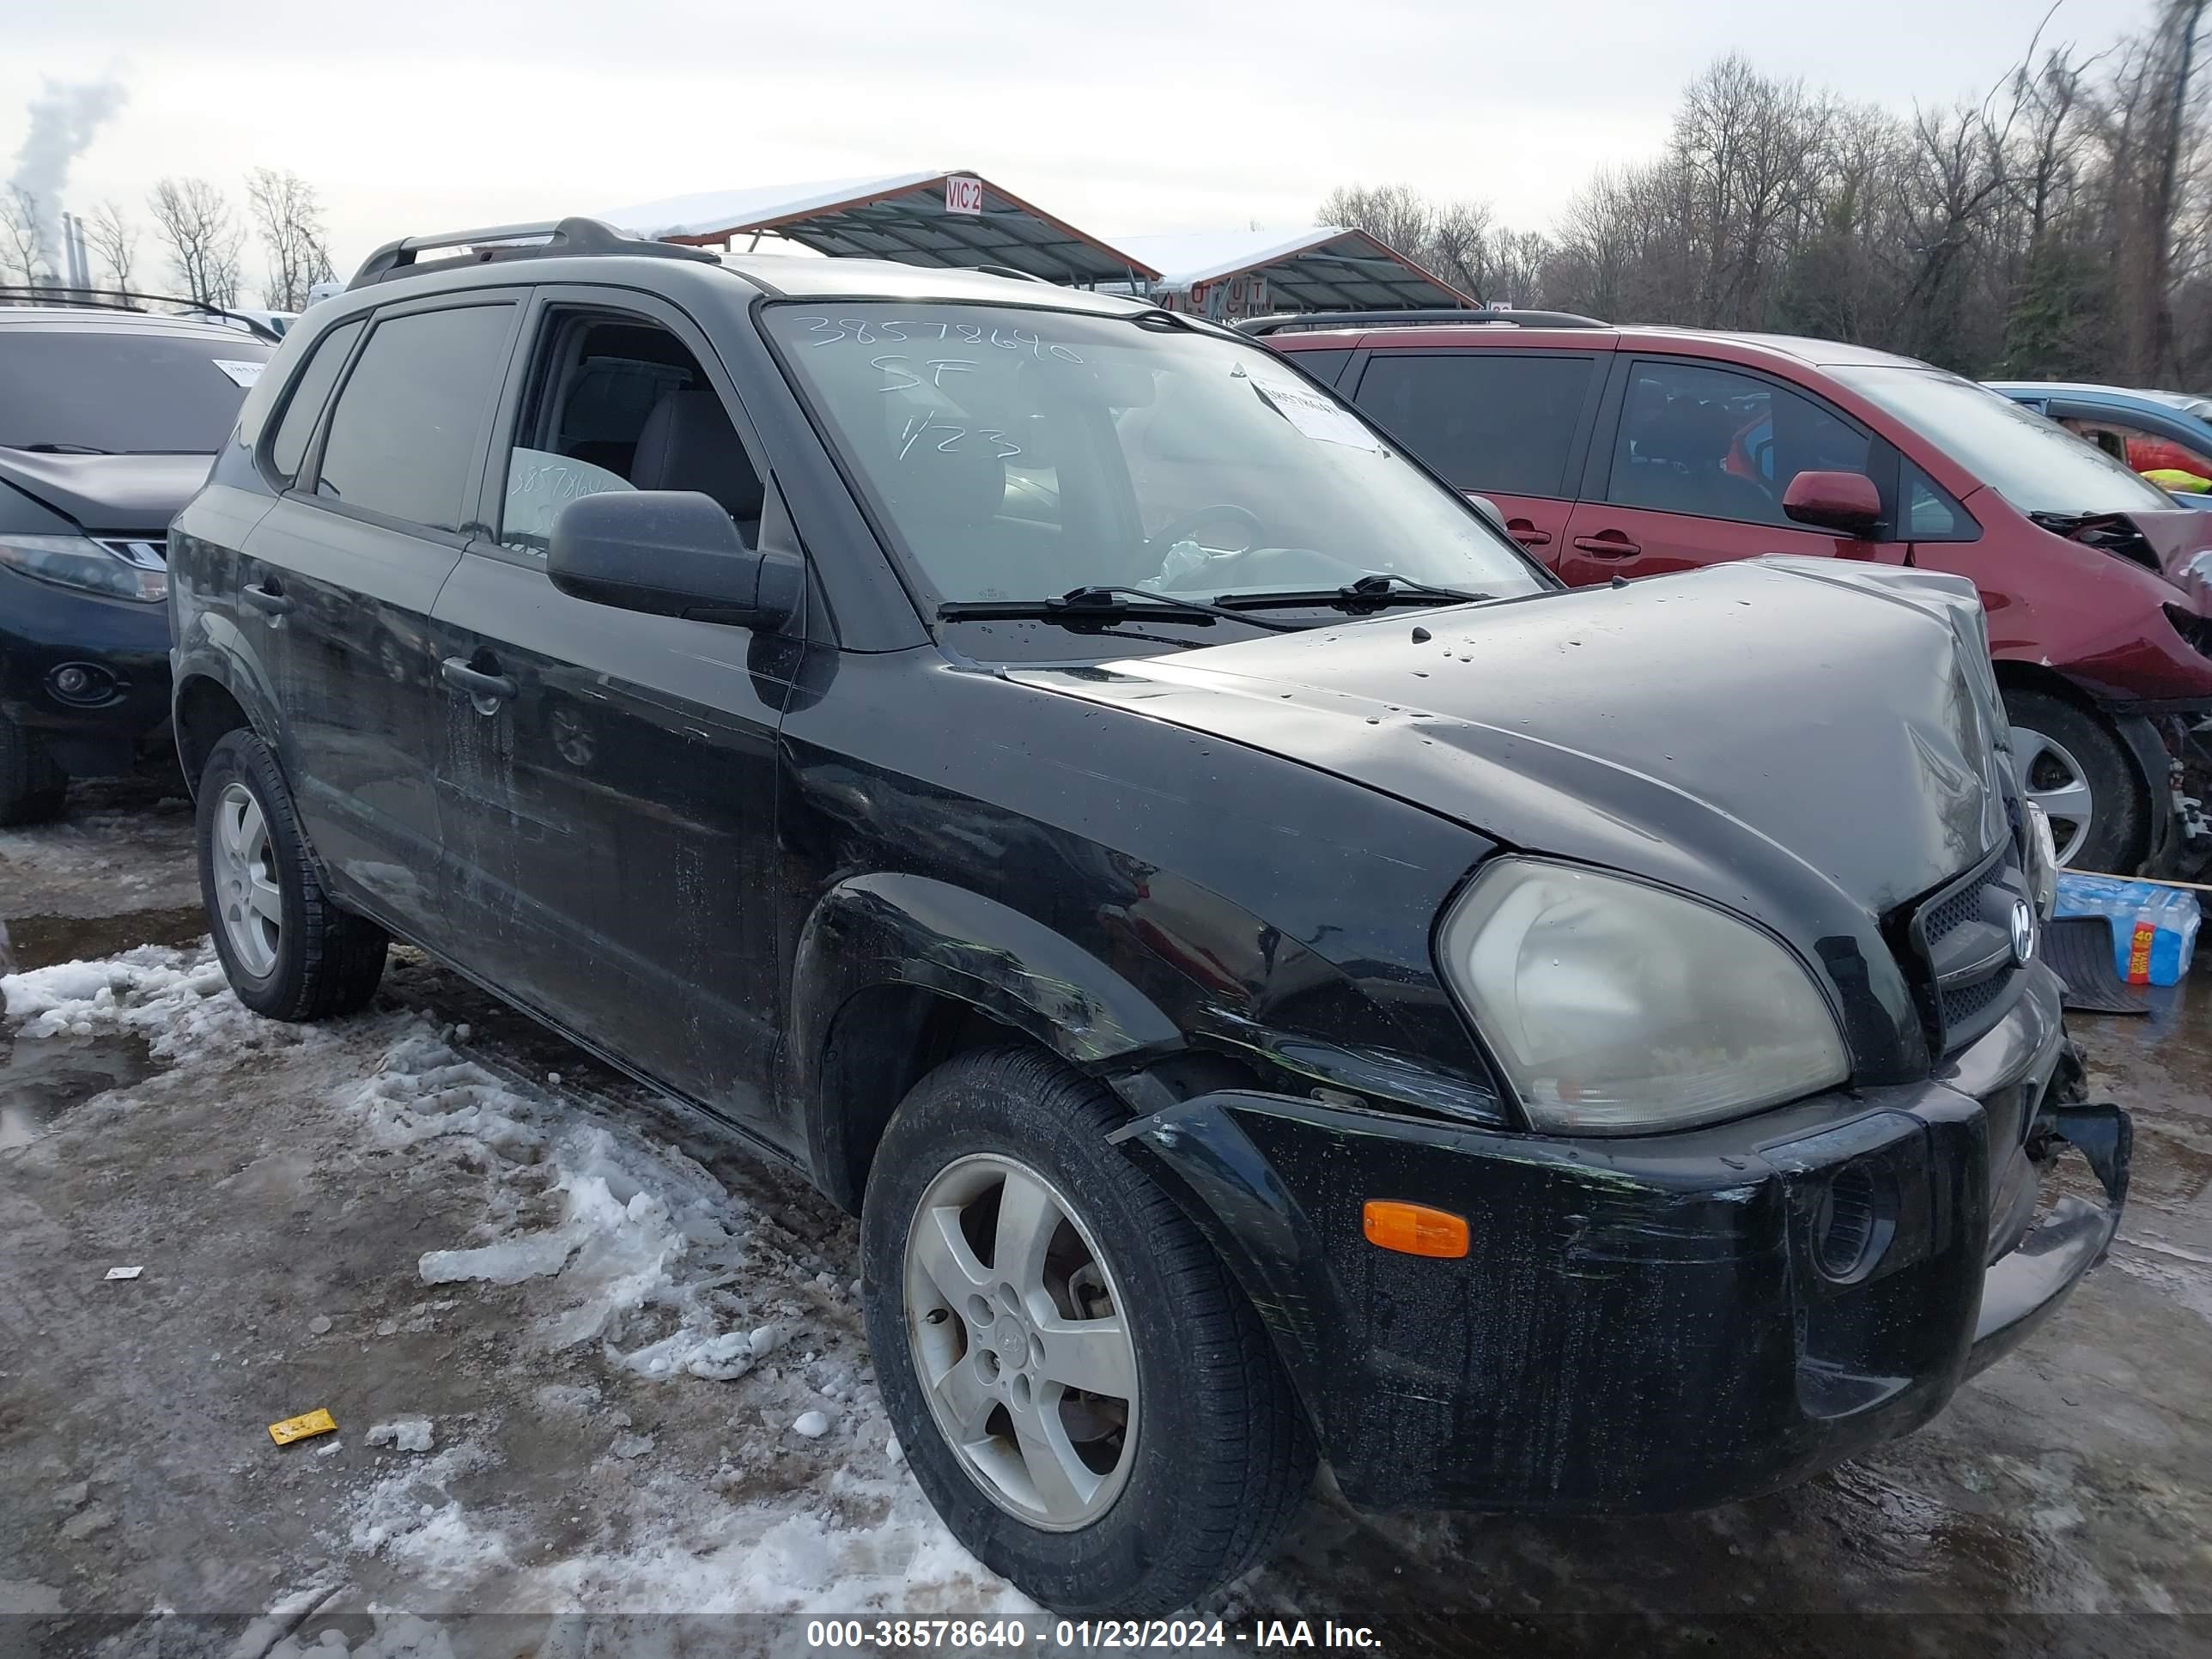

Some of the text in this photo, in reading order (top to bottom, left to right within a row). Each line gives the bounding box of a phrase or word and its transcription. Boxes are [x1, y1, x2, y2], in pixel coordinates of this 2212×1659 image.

[948, 180, 981, 210] VIC 2
[793, 317, 1085, 364] 38578640
[511, 465, 617, 500] 3857864
[2134, 930, 2153, 942] 40
